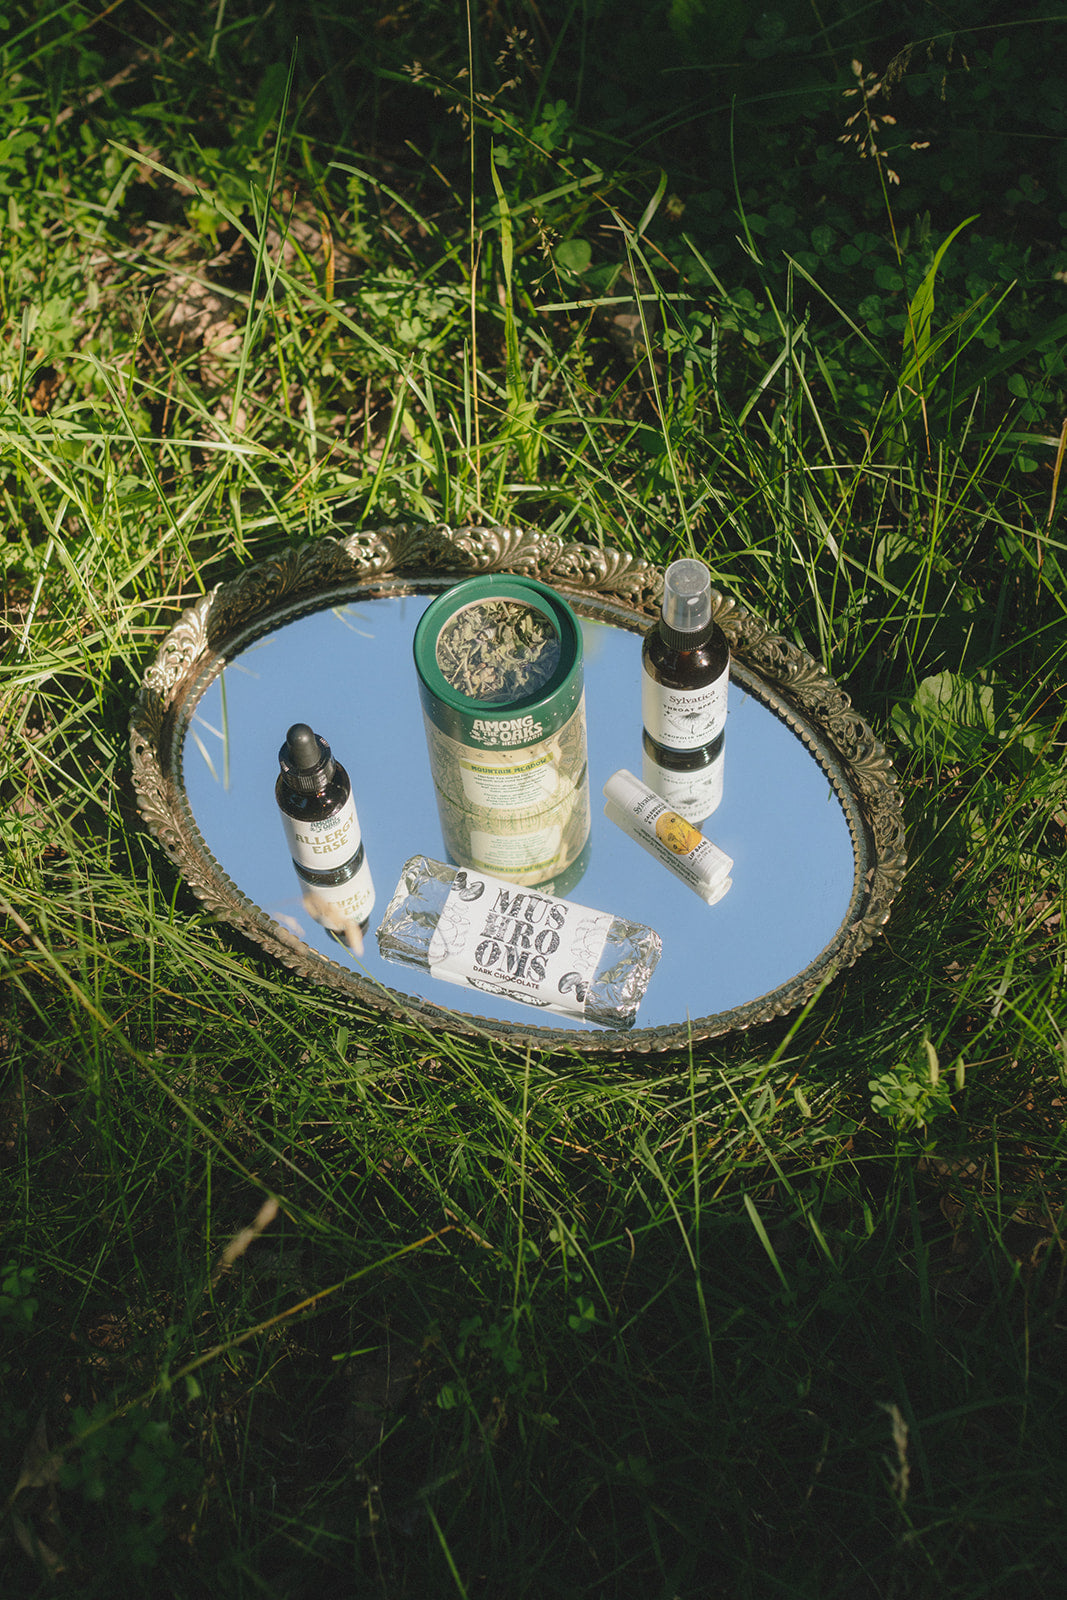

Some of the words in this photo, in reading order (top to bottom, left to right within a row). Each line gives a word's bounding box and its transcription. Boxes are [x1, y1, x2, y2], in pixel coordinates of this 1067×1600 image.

[669, 690, 715, 705] Sylvatica
[663, 704, 695, 713] THROAT
[472, 715, 534, 732] AMONG
[499, 722, 543, 742] OAKS
[523, 732, 543, 743] FARM
[471, 765, 512, 774] MOUNTAIN
[513, 758, 547, 773] MEADOW
[295, 812, 354, 845] ALLERGY
[312, 834, 349, 854] EASE
[489, 888, 569, 930] MUS
[472, 965, 493, 978] DARK
[493, 972, 540, 990] CHOCOLATE
